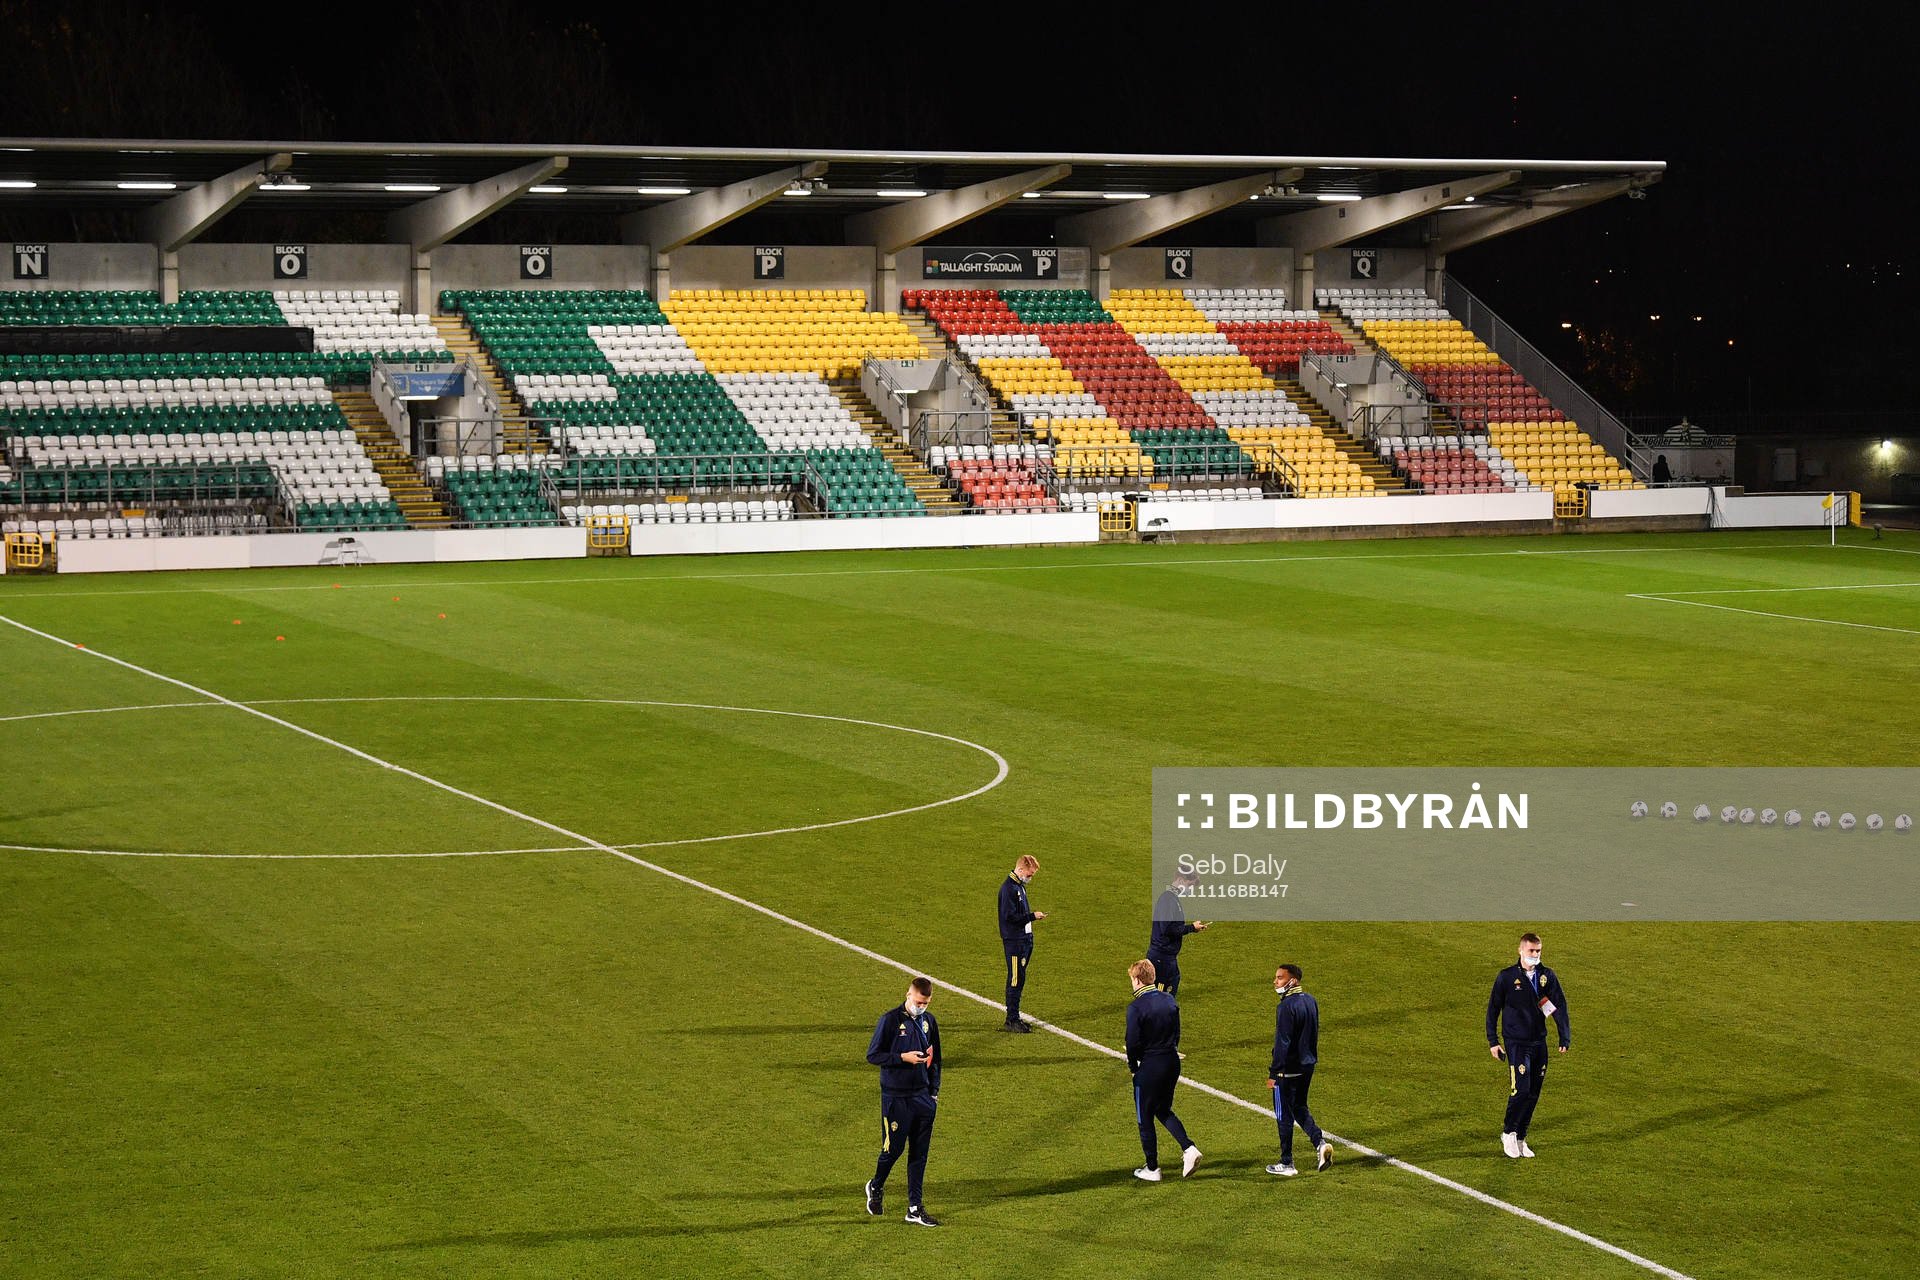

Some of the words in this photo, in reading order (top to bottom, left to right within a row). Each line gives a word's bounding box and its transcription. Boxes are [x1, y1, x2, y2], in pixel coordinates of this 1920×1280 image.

[16, 245, 46, 254] BLOCK
[276, 246, 304, 254] BLOCK
[523, 247, 550, 255] BLOCK
[756, 248, 782, 256] BLOCK
[1032, 249, 1056, 257] BLOCK
[1167, 249, 1191, 257] BLOCK
[21, 254, 42, 275] N
[281, 255, 300, 275] O
[527, 255, 545, 276] O
[761, 256, 777, 276] P
[940, 262, 983, 273] TALLAGHT
[983, 262, 1023, 273] STADIUM
[1037, 257, 1052, 276] P
[1172, 257, 1188, 278] Q
[1357, 257, 1371, 278] Q
